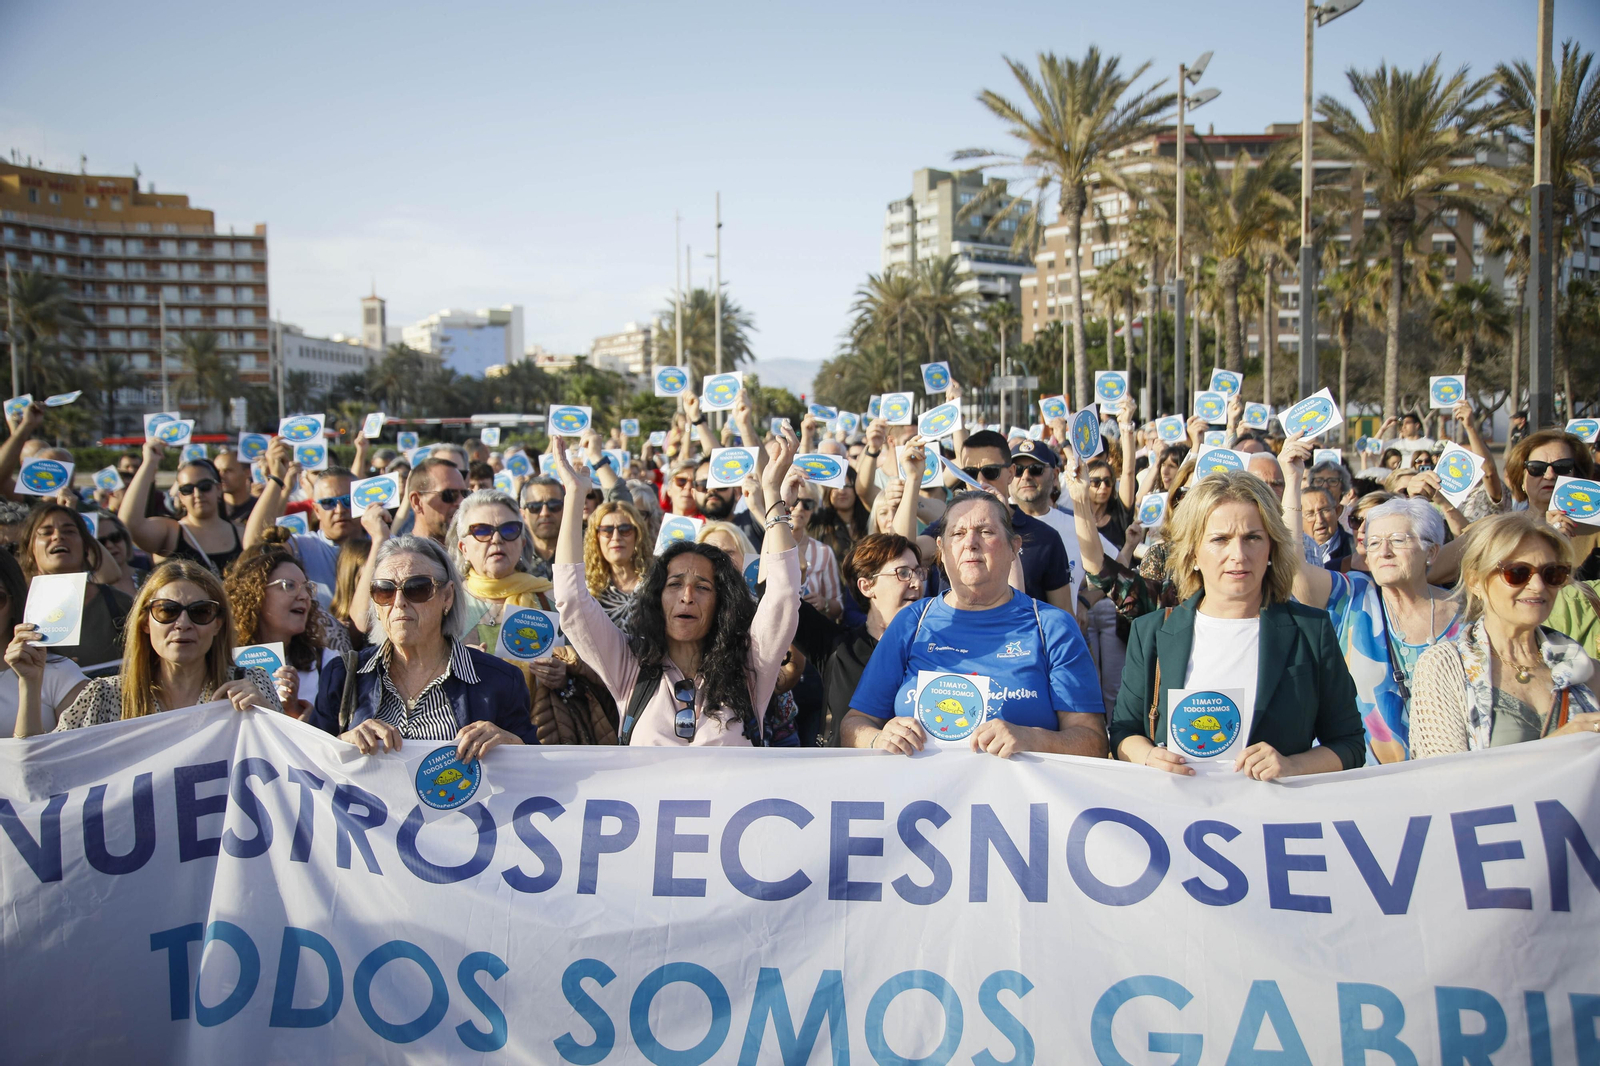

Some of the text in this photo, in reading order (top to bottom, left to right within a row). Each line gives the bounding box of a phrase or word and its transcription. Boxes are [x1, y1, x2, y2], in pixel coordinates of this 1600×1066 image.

[939, 680, 968, 690] 11MAYO
[930, 688, 974, 698] TODOS SOMOS
[1192, 698, 1222, 706] 11MAYO
[428, 749, 456, 766] 11MAYO
[422, 756, 458, 776] TODOS SOM
[150, 920, 509, 1053] TODOS
[553, 958, 1036, 1066] SOMOS
